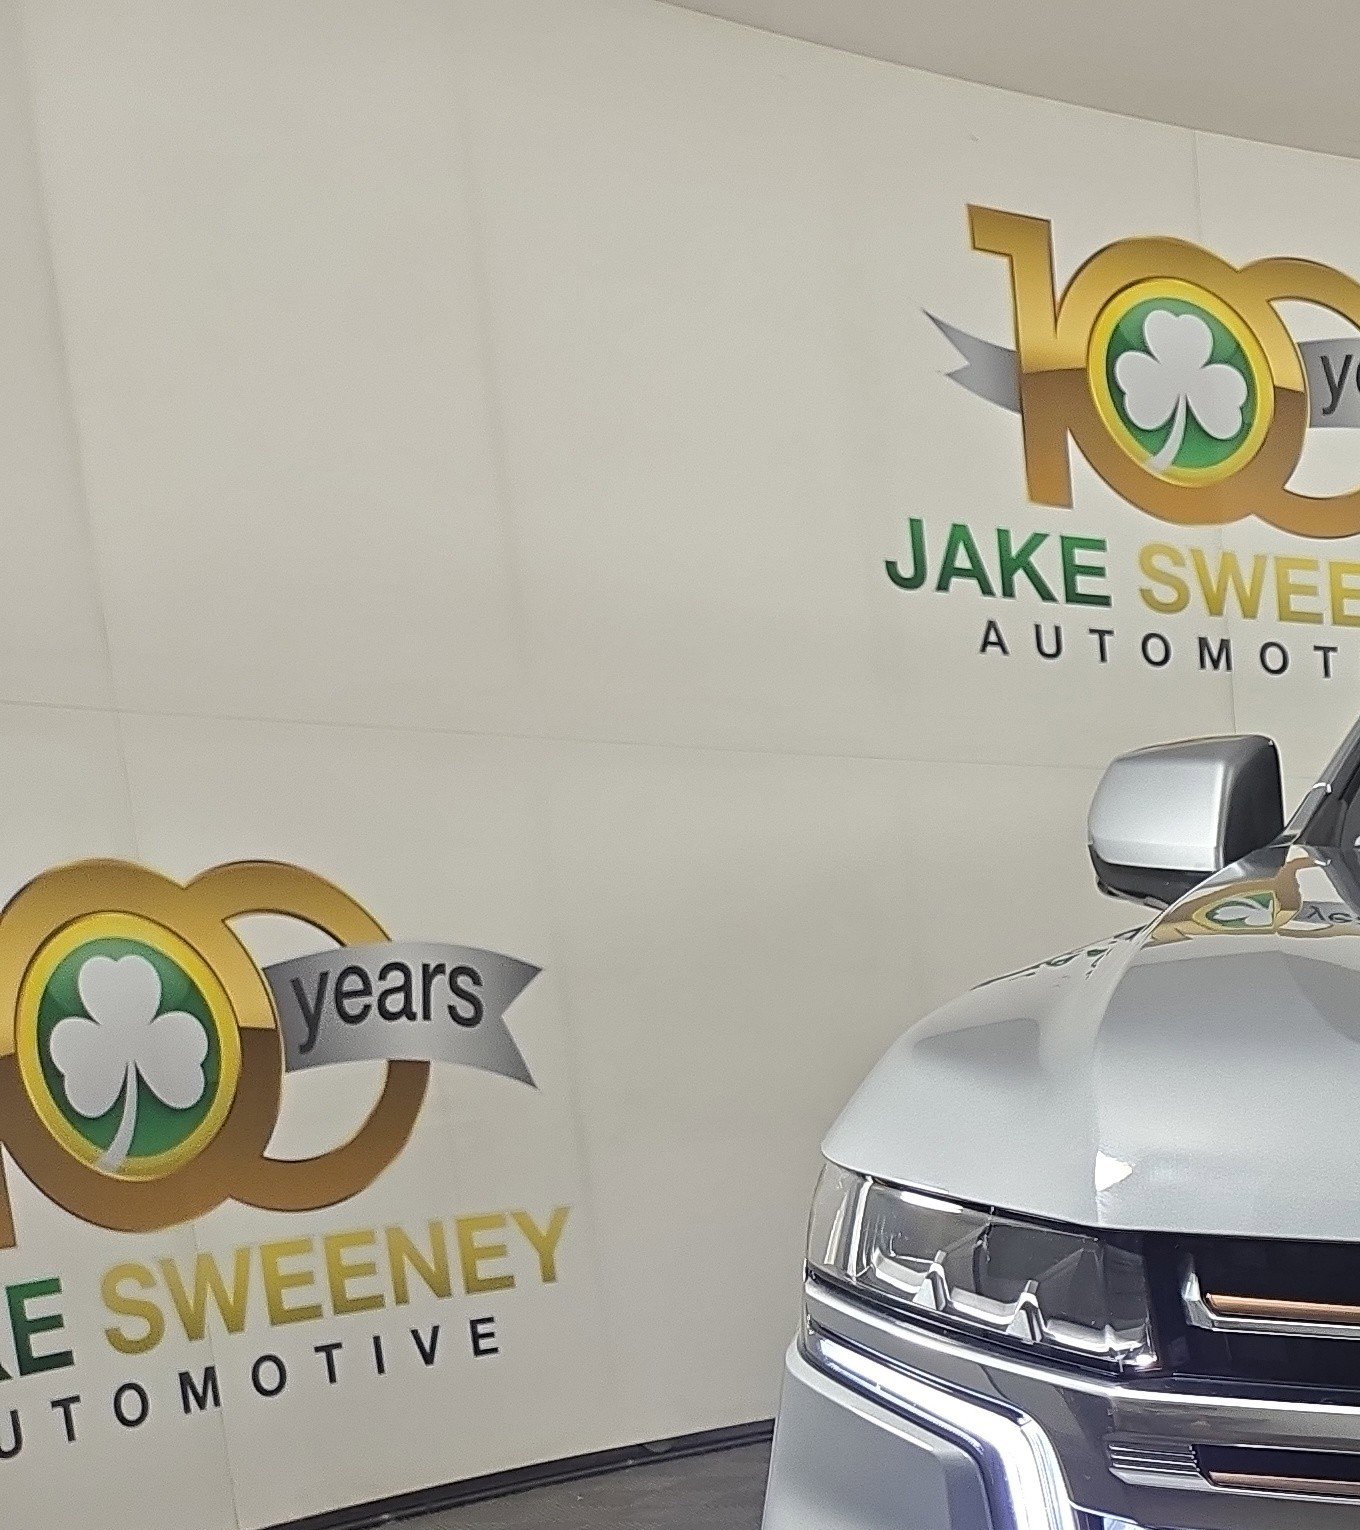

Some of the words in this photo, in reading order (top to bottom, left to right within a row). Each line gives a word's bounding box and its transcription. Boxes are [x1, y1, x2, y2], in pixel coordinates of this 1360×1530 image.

[884, 517, 1112, 607] JAKE
[0, 858, 430, 1249] 00
[290, 960, 484, 1054] years
[101, 1205, 574, 1355] SWEENEY
[0, 1316, 500, 1459] UTOMOTIVE
